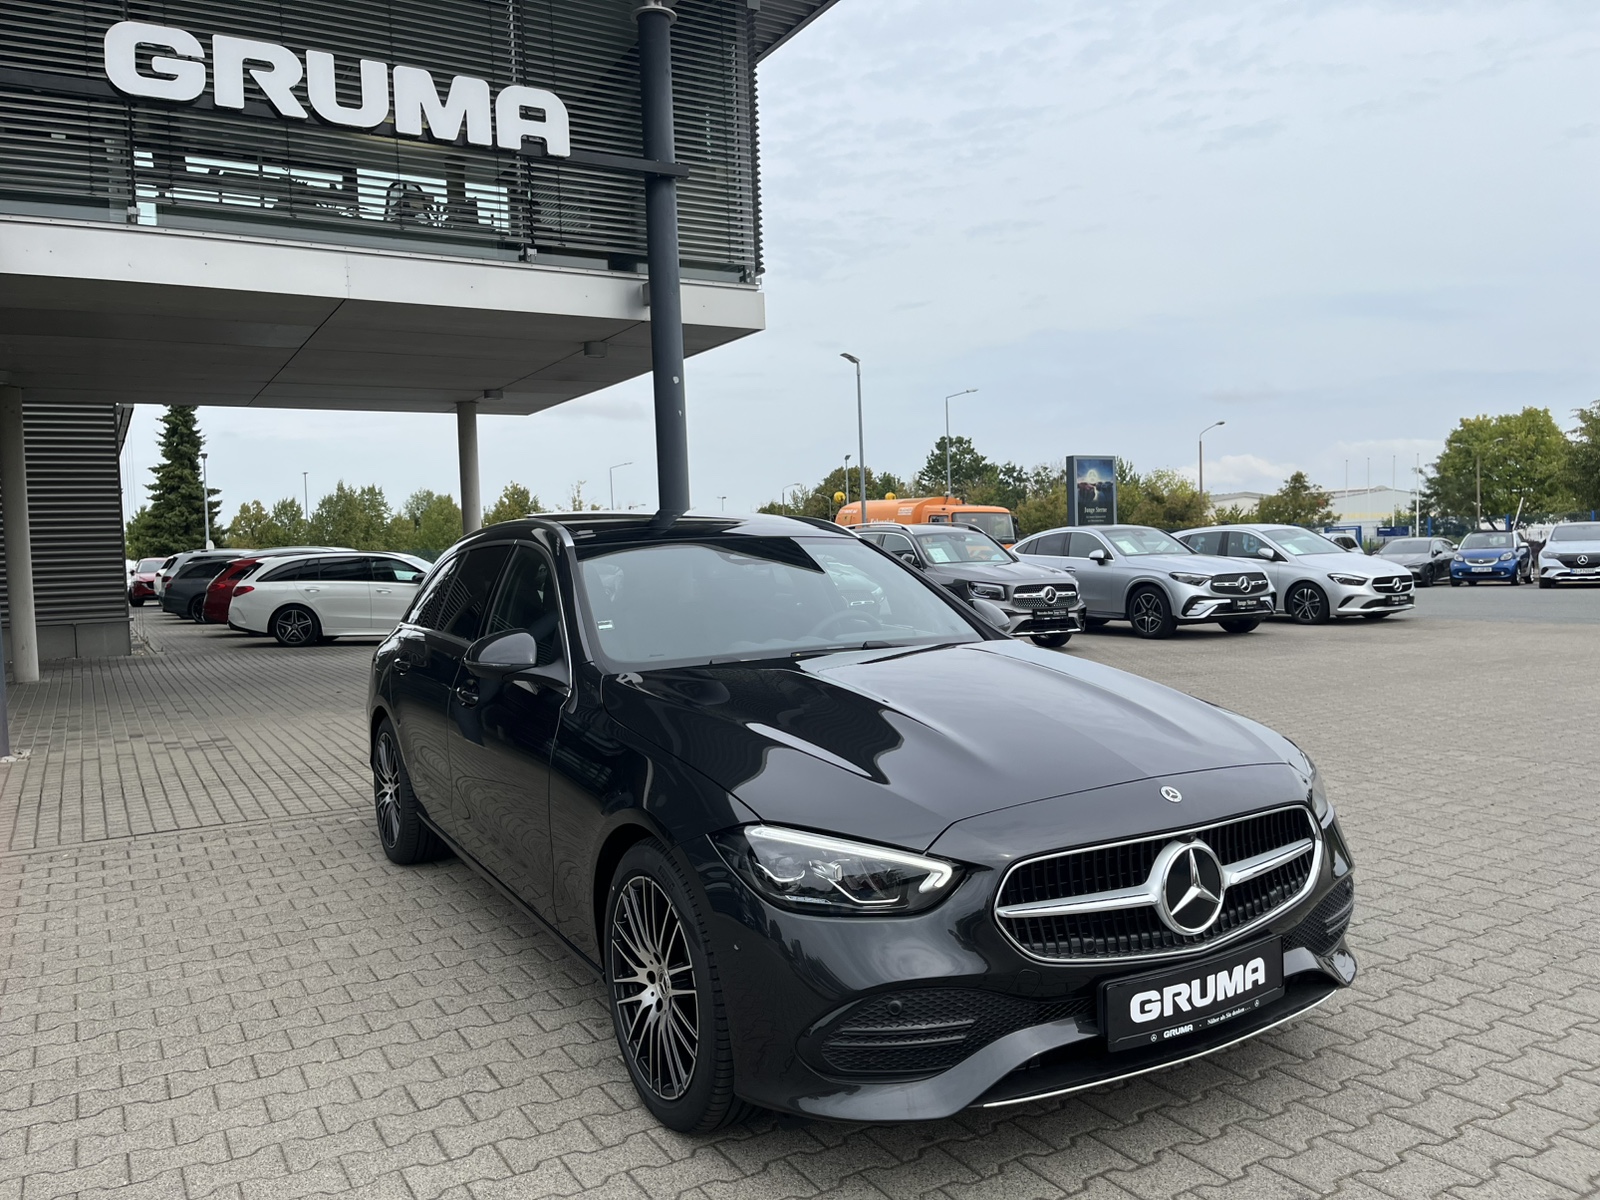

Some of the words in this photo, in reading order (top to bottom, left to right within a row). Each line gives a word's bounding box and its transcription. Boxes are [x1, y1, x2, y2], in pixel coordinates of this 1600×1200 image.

[104, 20, 570, 158] GRUMA
[1130, 957, 1266, 1024] GRUMA
[1164, 1024, 1193, 1038] GRUMA
